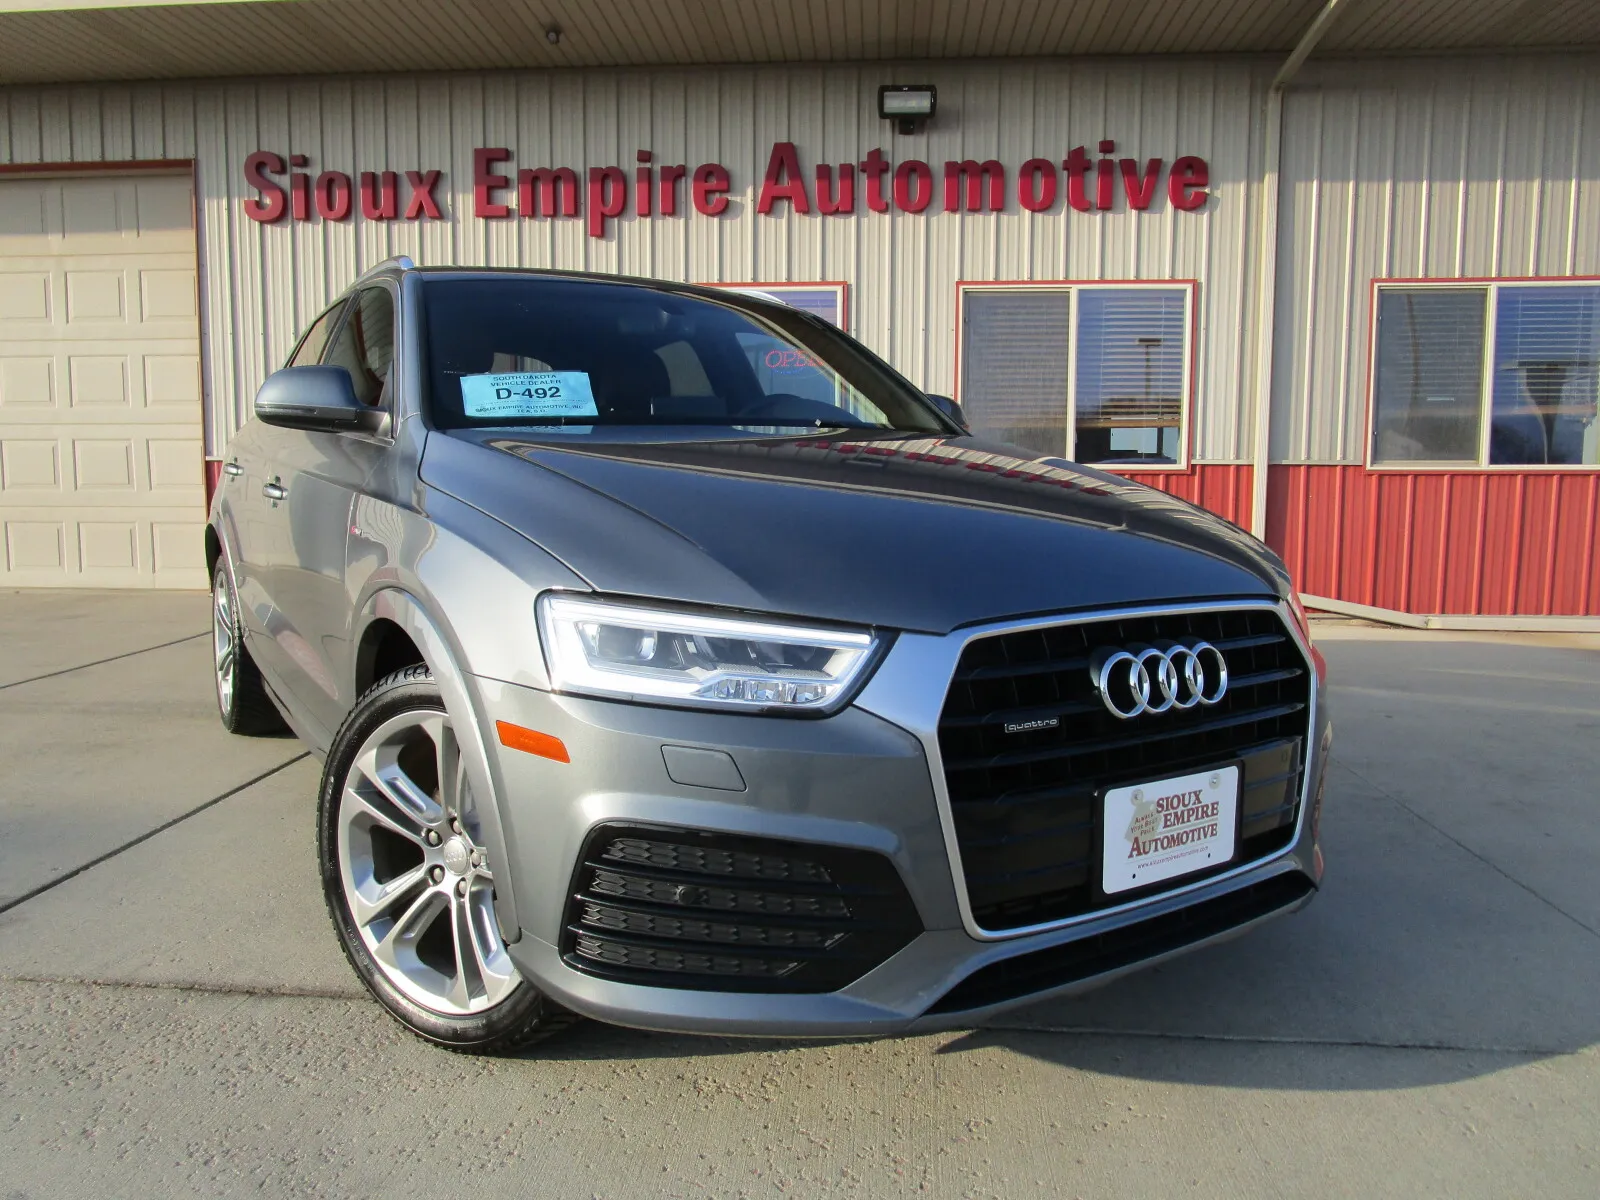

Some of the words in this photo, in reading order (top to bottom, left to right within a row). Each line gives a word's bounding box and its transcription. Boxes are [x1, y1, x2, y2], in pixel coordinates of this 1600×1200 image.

[243, 150, 443, 224] Sioux
[473, 147, 730, 238] Empire
[757, 140, 1209, 216] Automotive
[495, 386, 562, 400] D-492
[1008, 719, 1058, 731] quattro
[1156, 789, 1203, 814] SIOUX
[1162, 801, 1220, 829] EMPIRE
